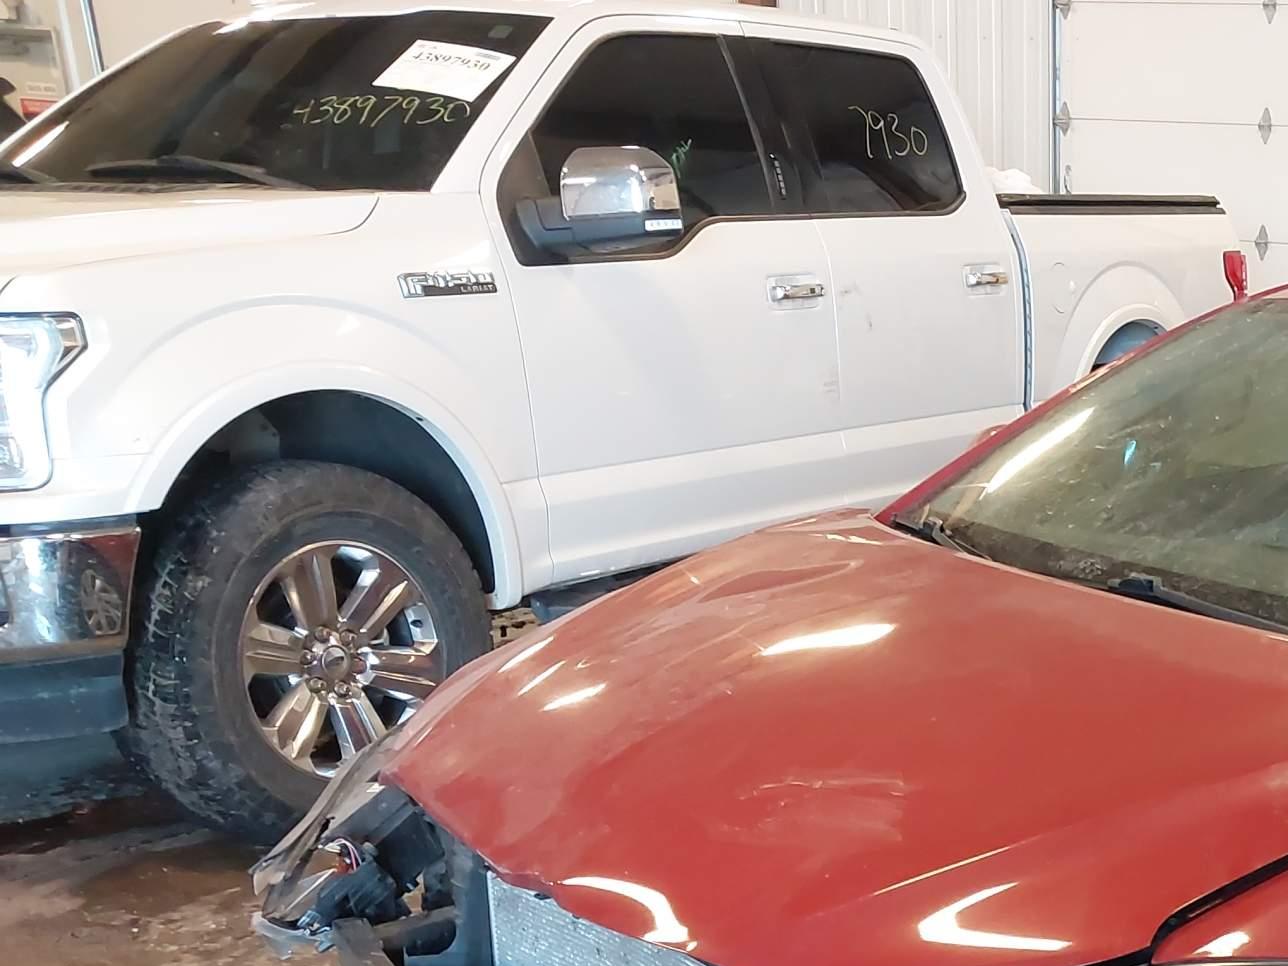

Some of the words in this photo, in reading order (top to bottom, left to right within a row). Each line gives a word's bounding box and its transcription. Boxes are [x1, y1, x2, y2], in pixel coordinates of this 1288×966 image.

[412, 51, 491, 71] 43897930
[293, 95, 471, 127] 43897930
[847, 105, 928, 159] 7930
